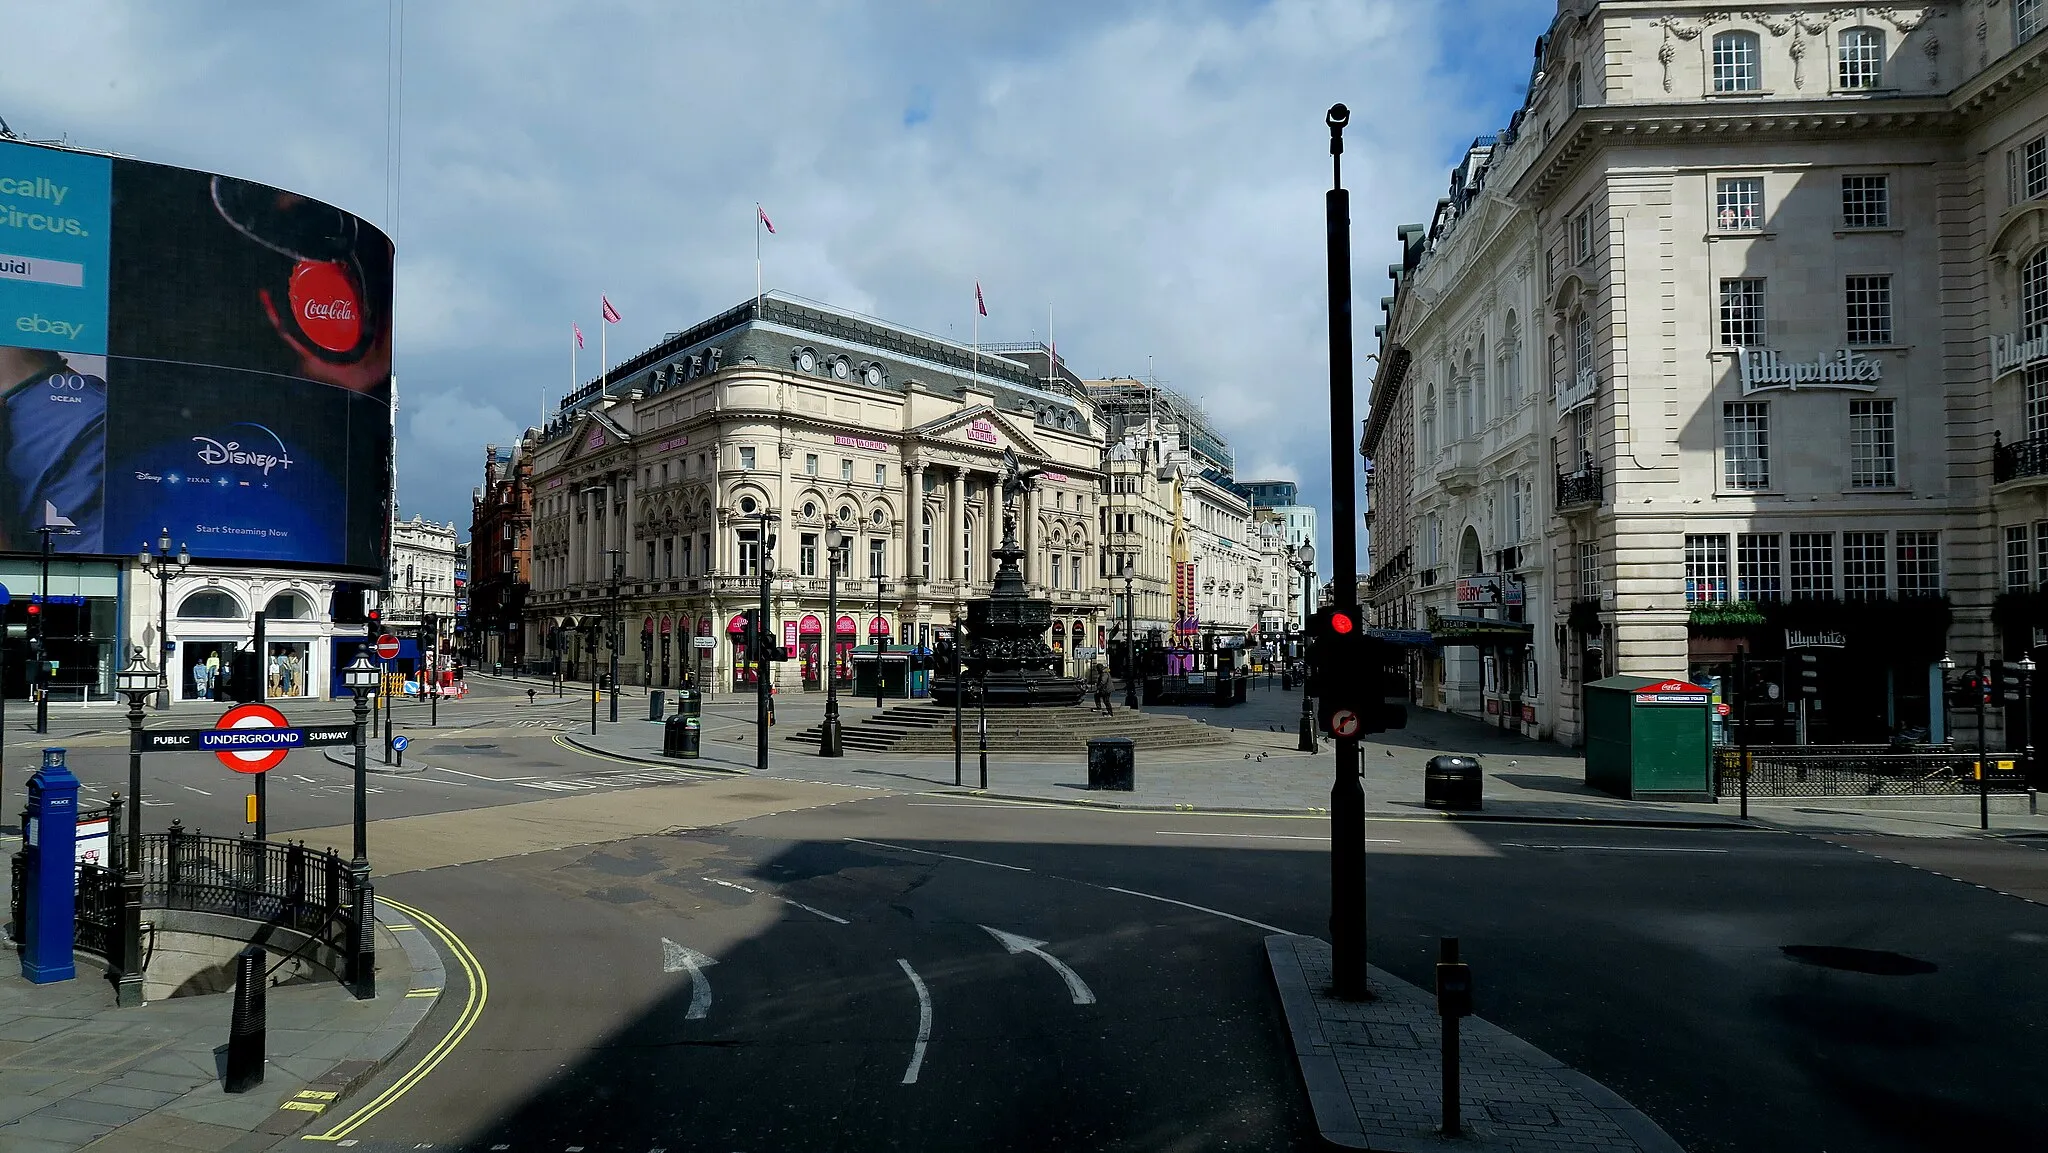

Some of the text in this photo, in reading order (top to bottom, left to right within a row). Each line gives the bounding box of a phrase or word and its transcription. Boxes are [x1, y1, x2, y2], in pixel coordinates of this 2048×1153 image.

[0, 176, 69, 206] cally
[304, 298, 352, 320] Coca-Cola
[16, 313, 84, 340] ebay
[1738, 346, 1882, 396] Lillywhites
[51, 395, 82, 403] OCEAN
[834, 435, 888, 452] BODY WORLDS
[192, 434, 293, 476] Disney+
[134, 471, 162, 483] Disney
[187, 476, 211, 484] PIXAR
[196, 524, 288, 538] Start Streaming Now
[1784, 627, 1848, 650] Lillywhites
[153, 731, 349, 745] PUBLIC UNDERGROUND SUBWAY
